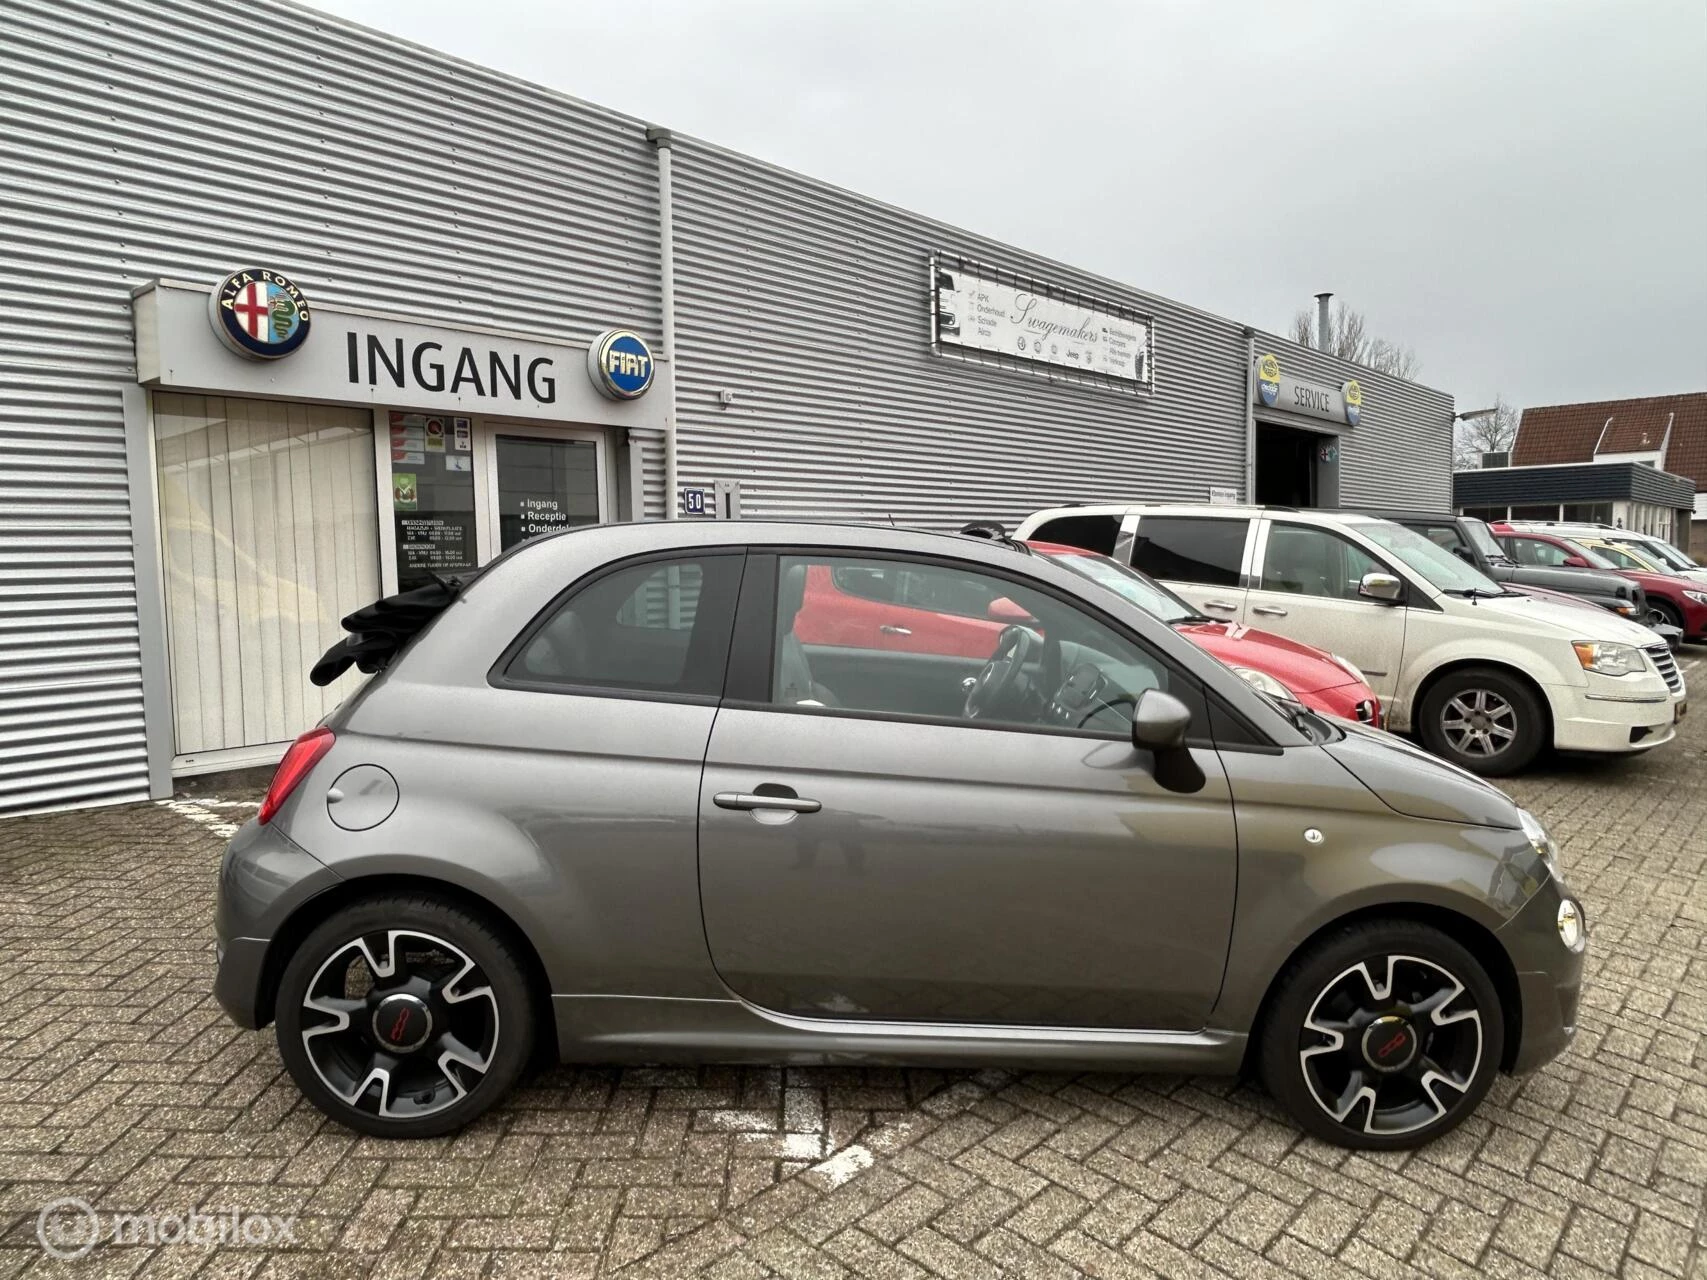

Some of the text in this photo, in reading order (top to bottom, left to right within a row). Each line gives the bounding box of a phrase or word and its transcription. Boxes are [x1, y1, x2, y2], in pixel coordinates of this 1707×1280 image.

[221, 270, 309, 321] ALFA ROMEO
[1010, 293, 1098, 343] Swagemakers
[347, 331, 556, 404] INGANG
[609, 349, 649, 378] FIAT
[1294, 385, 1330, 413] SERVICE
[527, 498, 558, 511] Ingang
[688, 493, 702, 509] 50
[527, 511, 567, 523] Receptie
